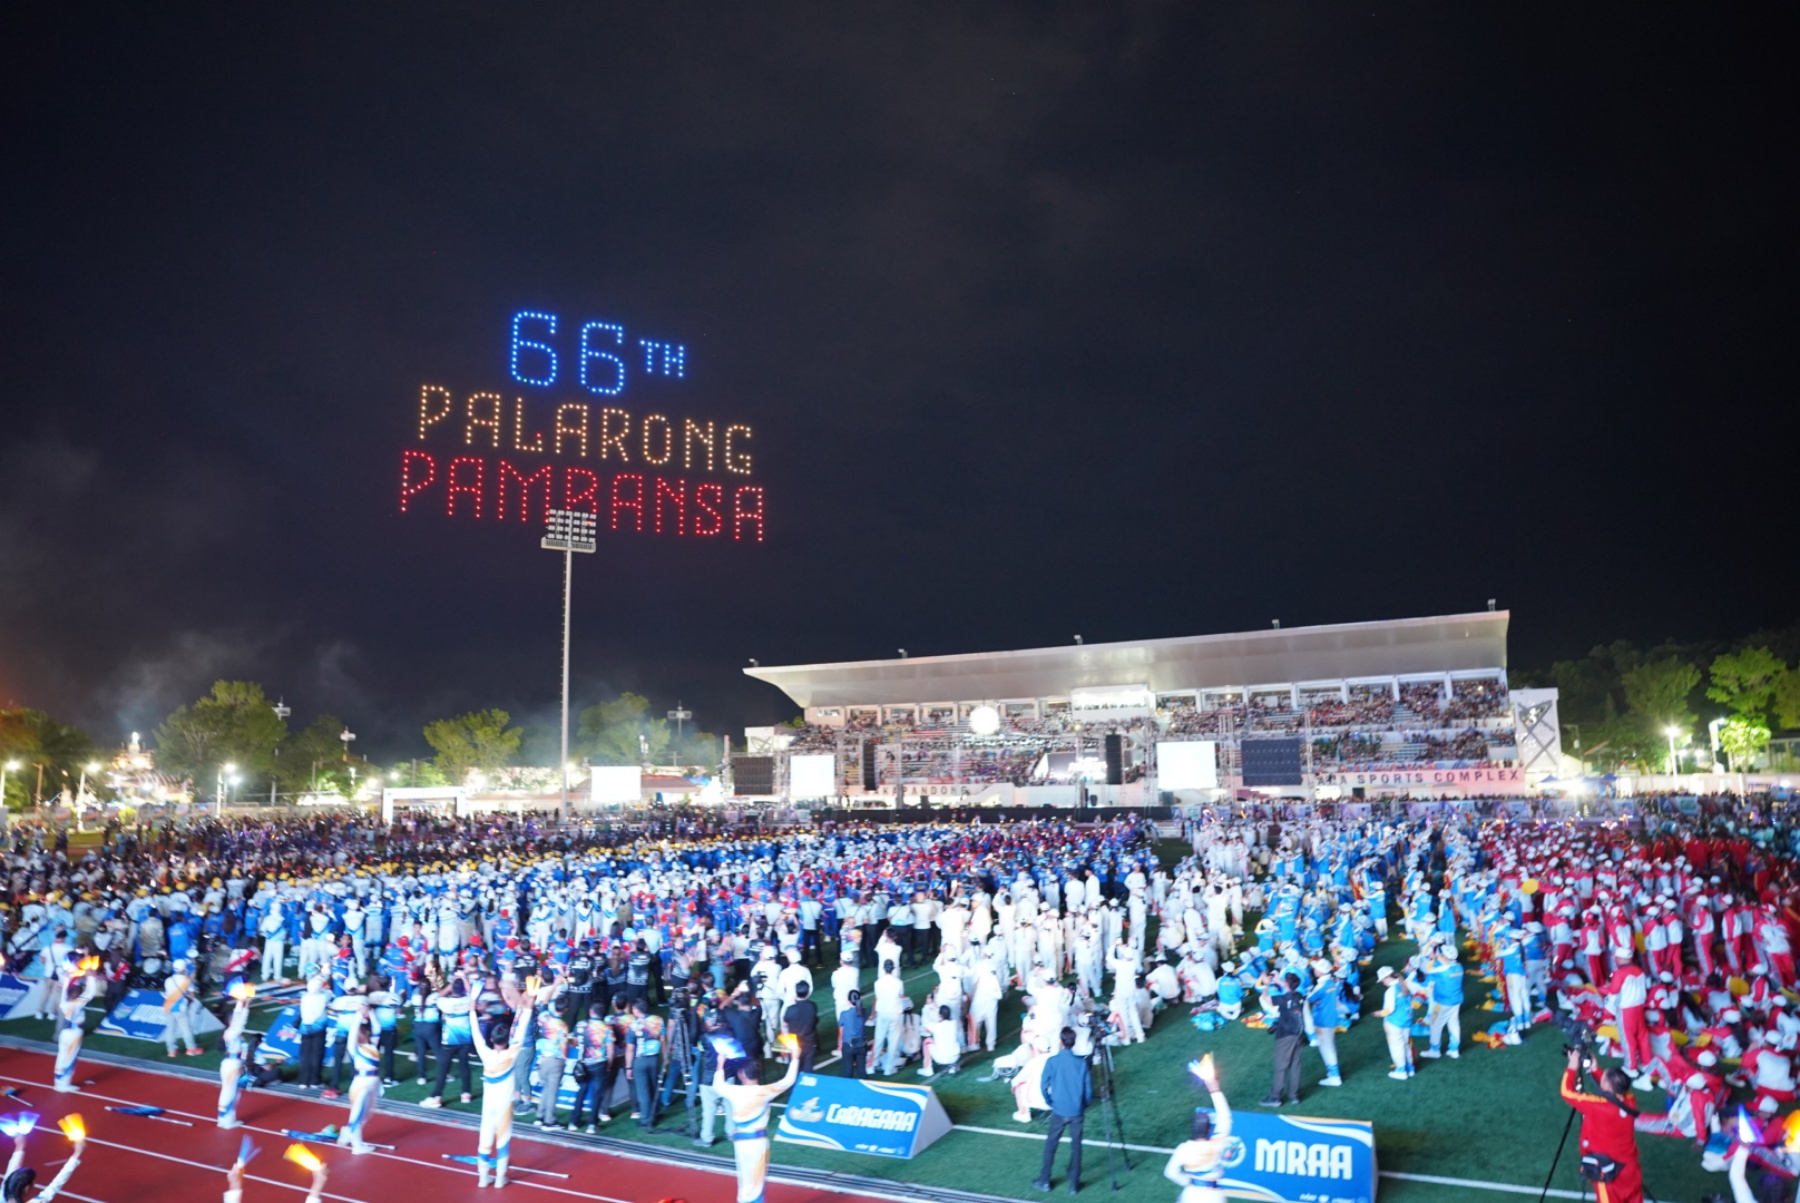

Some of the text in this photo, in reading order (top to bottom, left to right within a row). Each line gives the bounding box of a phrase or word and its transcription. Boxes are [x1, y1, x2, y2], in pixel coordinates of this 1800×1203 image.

[418, 384, 752, 475] PALARONG
[1357, 772, 1424, 786] SPORTS
[1433, 769, 1520, 784] COMPLEX
[1254, 1137, 1353, 1180] MRAA
